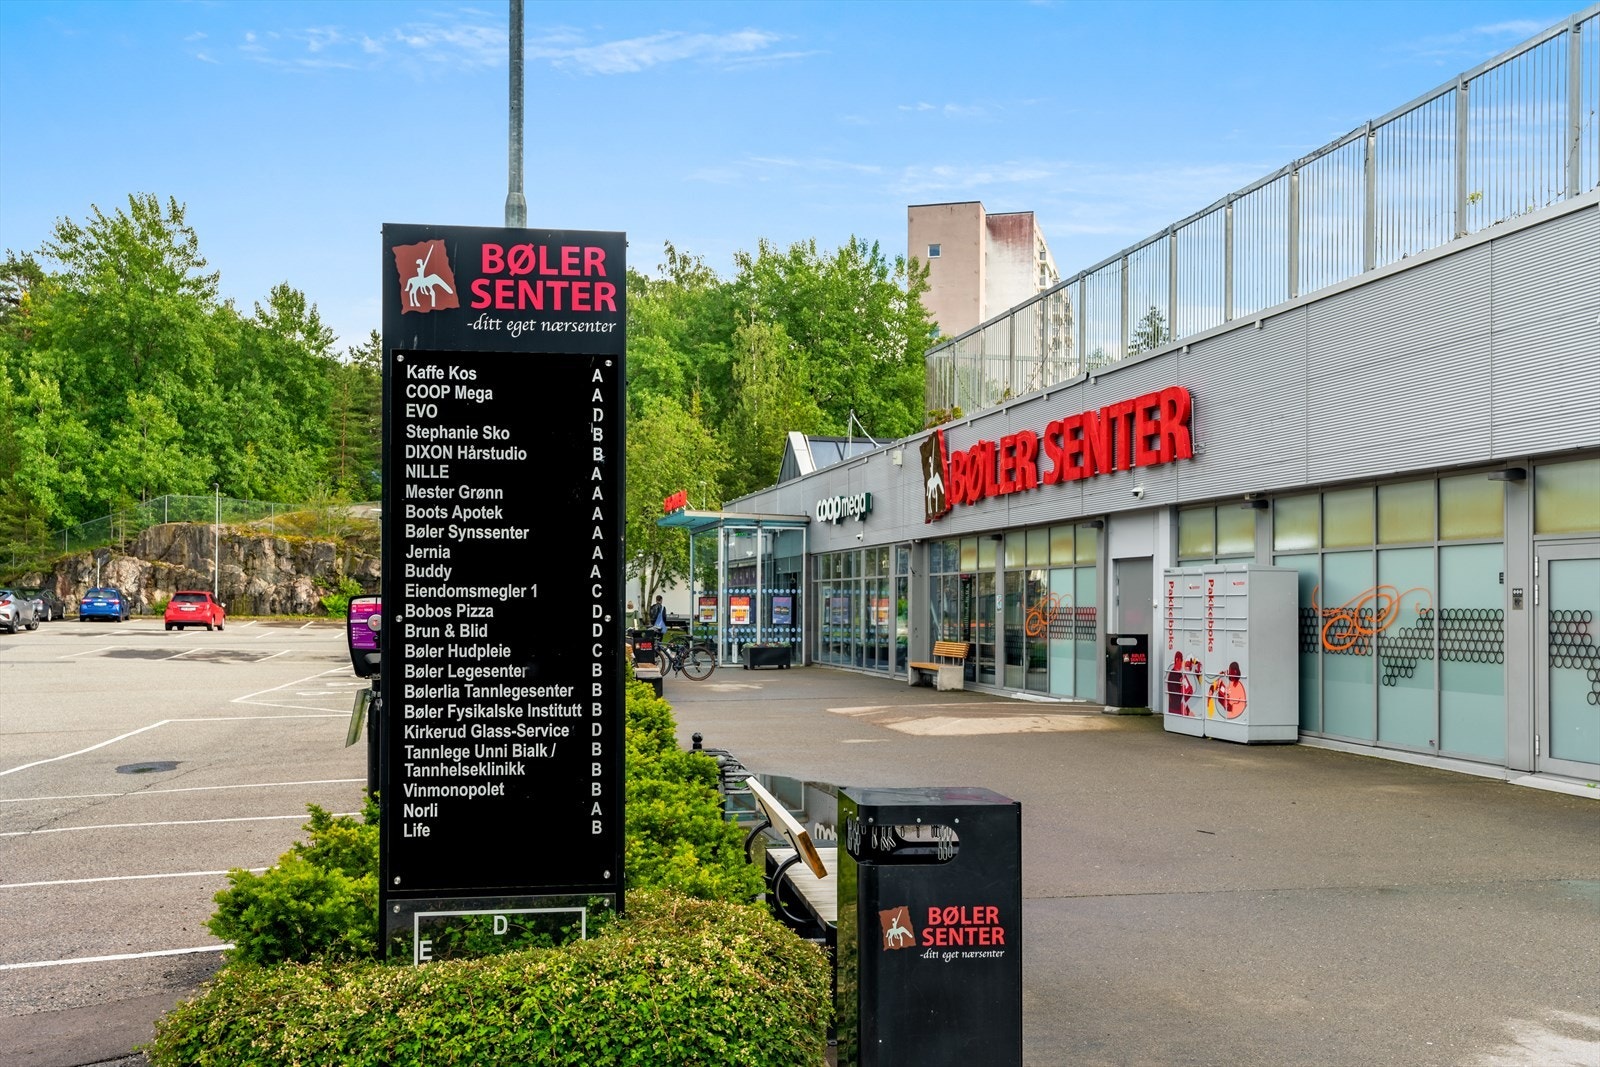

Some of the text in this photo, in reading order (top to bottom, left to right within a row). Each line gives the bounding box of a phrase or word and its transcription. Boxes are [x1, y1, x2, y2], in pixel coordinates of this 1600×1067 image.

[481, 243, 607, 276] BØLER
[471, 278, 617, 312] SENTER
[467, 312, 617, 338] -ditt eget nærsenter
[406, 364, 604, 383] Kaffe Kos A
[406, 384, 604, 403] COOP Mega A
[406, 404, 604, 422] EVO D
[406, 424, 604, 443] Stephanie Sko B
[406, 445, 604, 462] DIXON Hårstudio B
[951, 385, 1193, 506] BØLER SENTER
[406, 464, 603, 481] NILLE A
[406, 484, 604, 501] Mester Grønn A
[406, 505, 604, 522] Boots Apotek A
[816, 491, 867, 526] coop mega
[406, 524, 604, 542] Bøler Synssenter A
[406, 544, 604, 560] Jernia A
[405, 564, 602, 581] Buddy A
[405, 584, 527, 601] Eiendomsmegler
[592, 584, 603, 598] C
[405, 604, 603, 619] Bobos Pizza D
[405, 624, 440, 638] Brun
[460, 624, 488, 638] Blid
[593, 623, 603, 638] D
[405, 644, 603, 661] Bøler Hudpleie C
[405, 663, 603, 682] Bøler Legesenter B
[405, 683, 603, 702] Bølerlia Tannlegesenter B
[405, 703, 603, 722] Bøler Fysikalske Institutt B
[405, 723, 603, 739] Kirkerud Glass-Service D
[405, 744, 471, 763] Tannlege
[475, 744, 508, 759] Unni
[513, 743, 548, 758] Bialk
[592, 742, 602, 757] B
[405, 762, 602, 777] Tannhelseklinikk B
[403, 782, 602, 799] Vinmonopolet B
[404, 802, 603, 818] Norli A
[404, 820, 603, 837] Life B
[928, 906, 999, 926] BØLER
[493, 916, 509, 936] D
[922, 927, 1005, 946] SENTER
[419, 940, 433, 961] E
[942, 951, 960, 963] eget
[961, 950, 1006, 959] nærsenter
